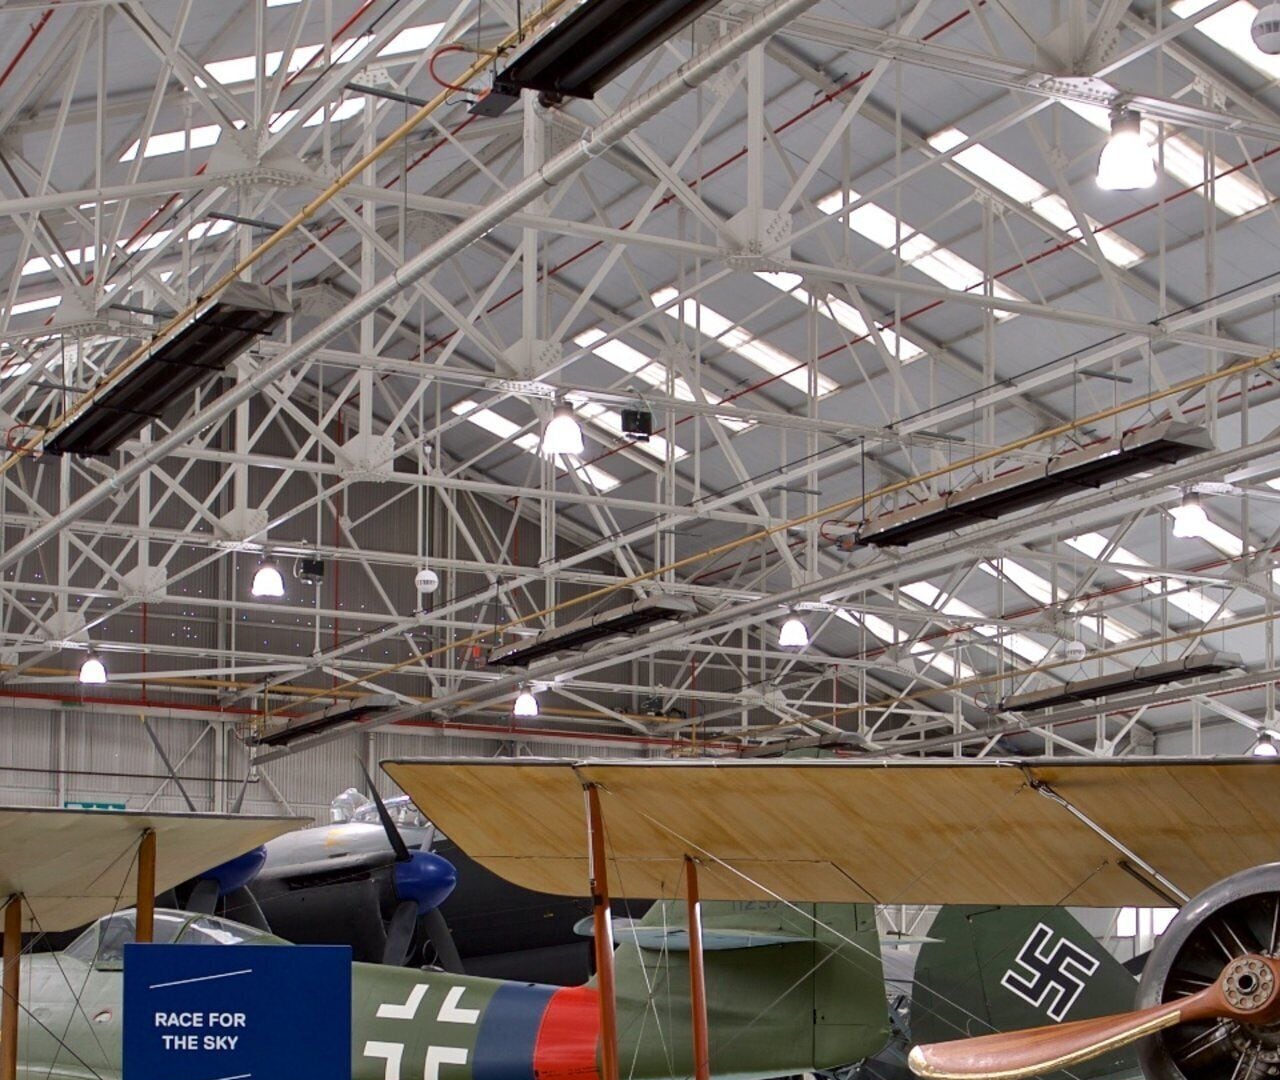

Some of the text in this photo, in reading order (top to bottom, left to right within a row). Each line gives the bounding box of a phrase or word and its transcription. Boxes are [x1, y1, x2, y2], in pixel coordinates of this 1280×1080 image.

[155, 1012, 246, 1027] RACE FOR
[162, 1035, 239, 1049] THE SKY
